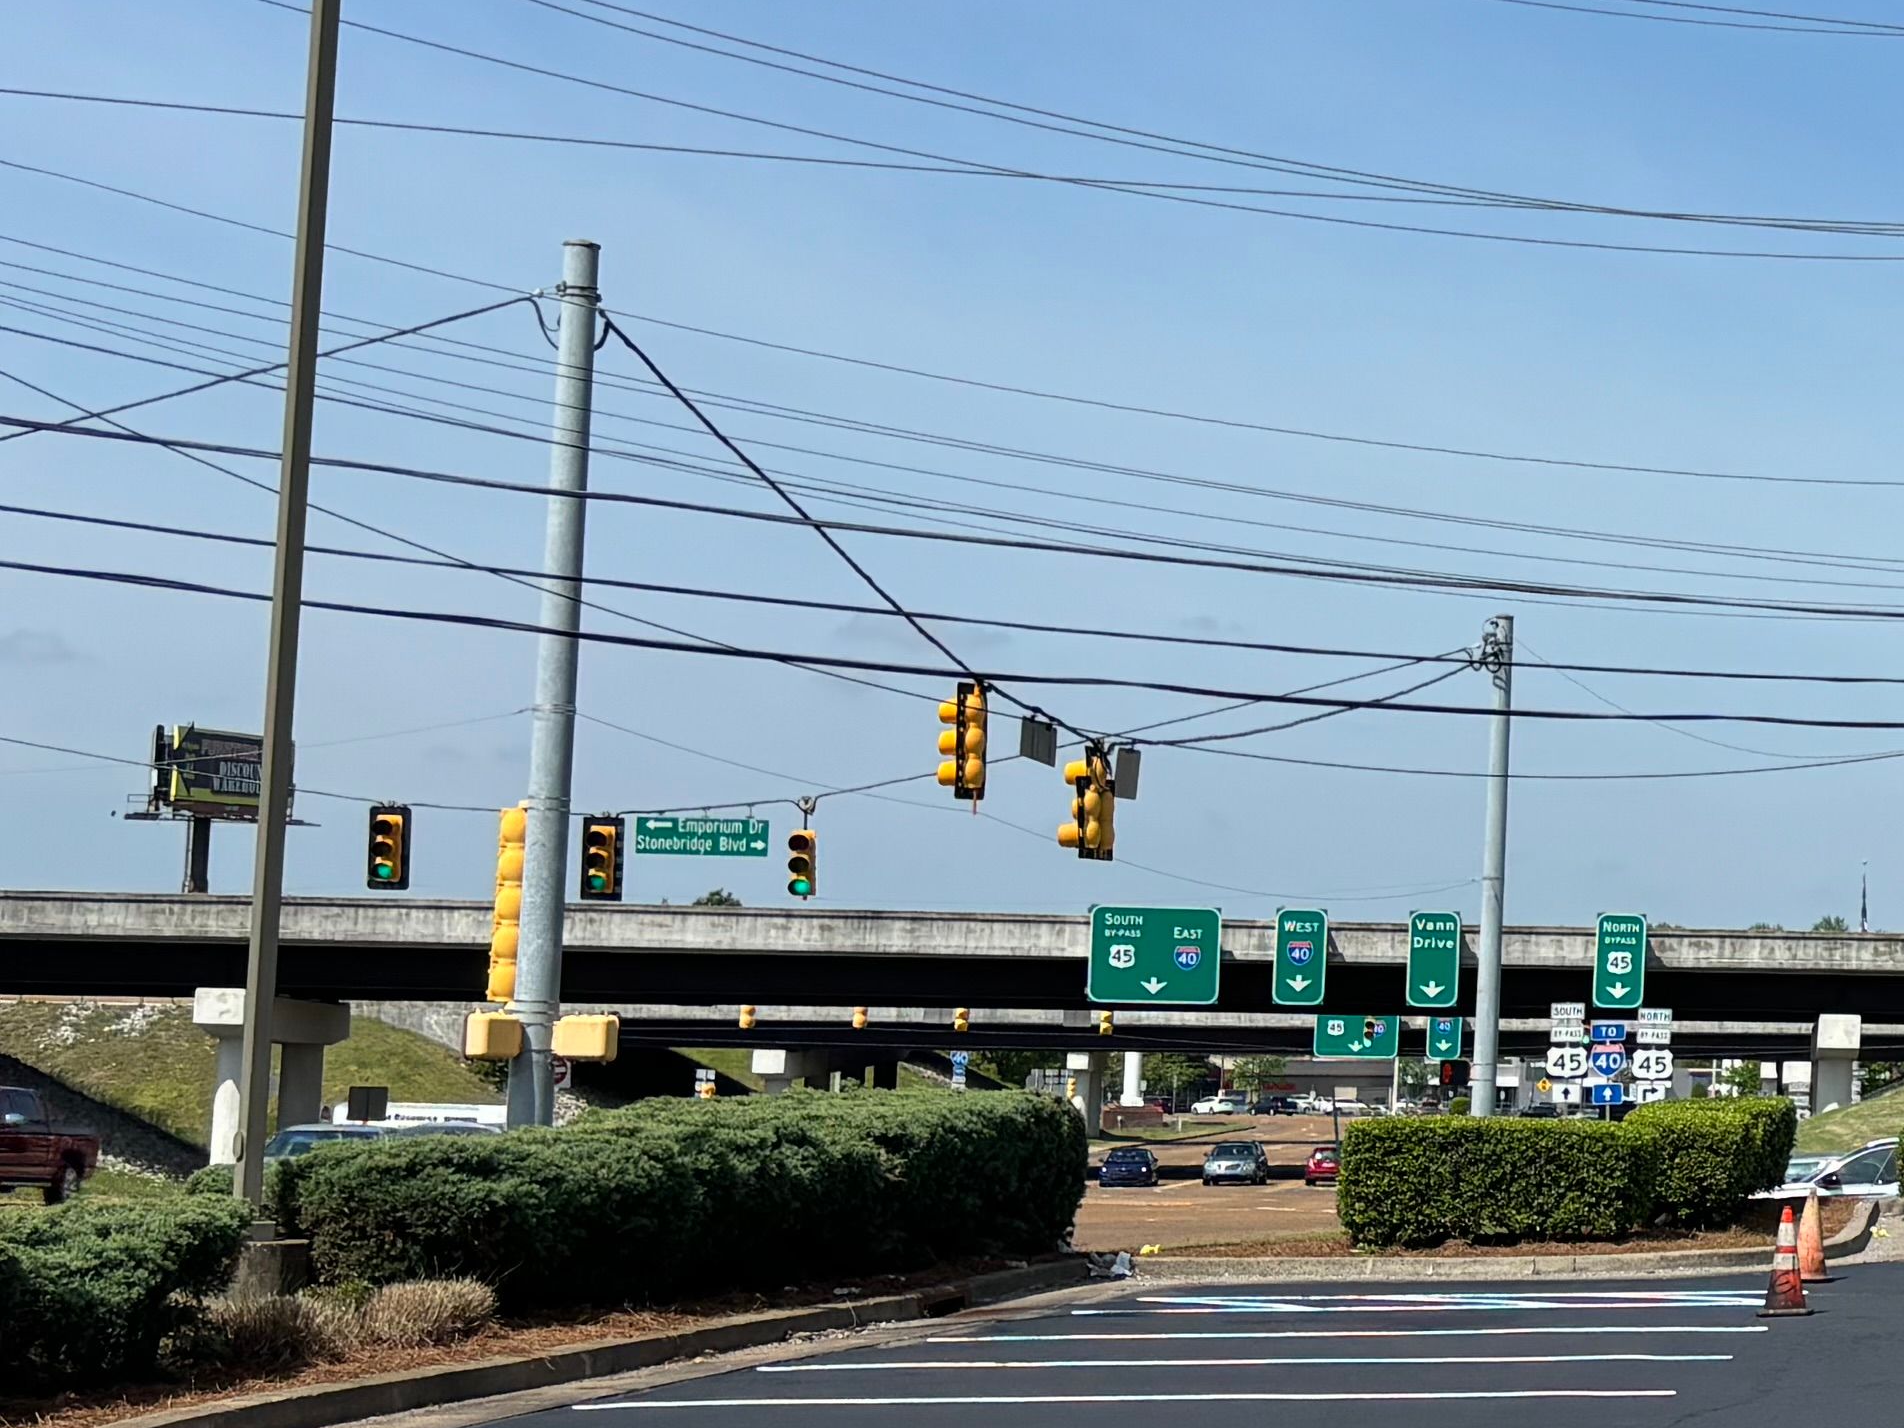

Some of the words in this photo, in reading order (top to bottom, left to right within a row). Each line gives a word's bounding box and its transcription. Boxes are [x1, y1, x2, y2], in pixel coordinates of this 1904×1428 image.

[219, 761, 262, 779] DISCOUN
[678, 818, 743, 836] Emporium
[749, 818, 764, 834] Dr
[637, 835, 712, 855] Stonebridge
[719, 836, 747, 852] Blvd
[1104, 913, 1143, 925] SOUTH
[1415, 918, 1455, 931] Vann
[1173, 927, 1203, 939] EAST
[1284, 920, 1319, 933] WEST
[1603, 921, 1640, 932] NORTH
[1413, 936, 1455, 949] Drive
[1112, 949, 1132, 963] 45
[1178, 952, 1197, 965] 40
[1291, 947, 1310, 960] 40
[1610, 956, 1630, 969] 45
[1553, 1006, 1583, 1016] SOUTH
[1640, 1012, 1670, 1021] NORTH
[1329, 1023, 1342, 1033] 45
[1600, 1027, 1617, 1037] TO
[1553, 1054, 1581, 1071] 45
[1595, 1053, 1621, 1069] 40
[1639, 1056, 1666, 1073] 45
